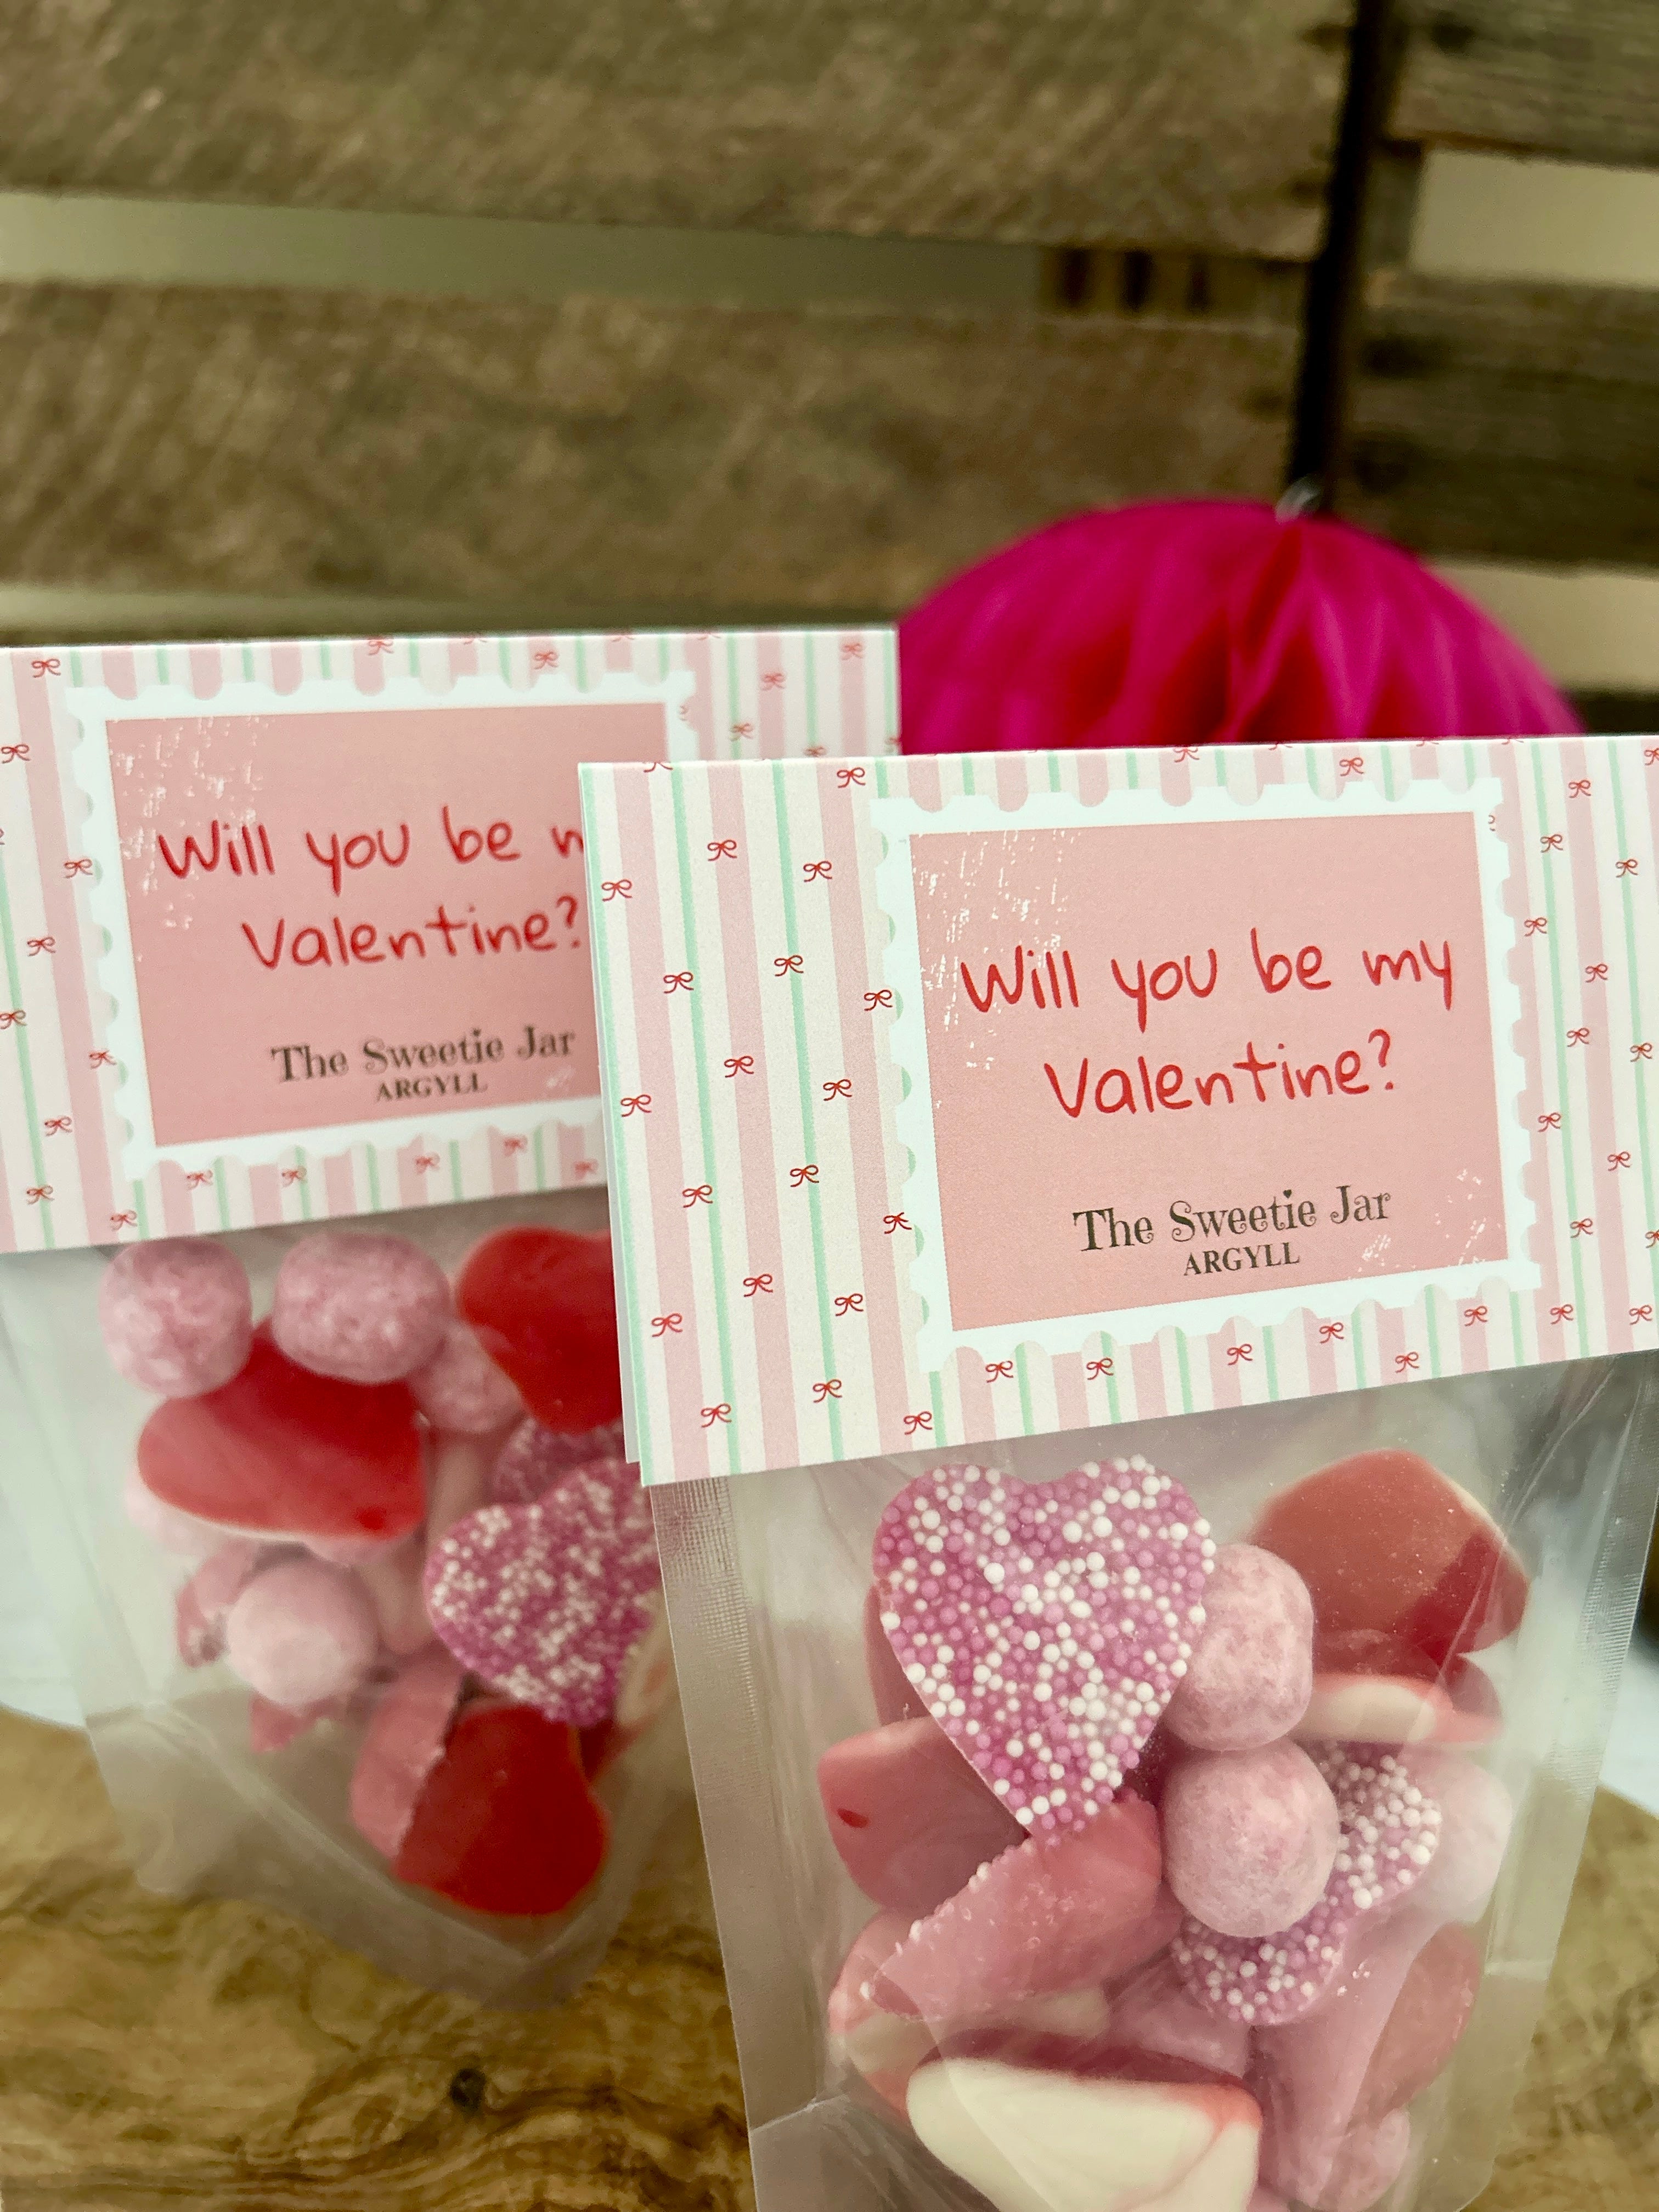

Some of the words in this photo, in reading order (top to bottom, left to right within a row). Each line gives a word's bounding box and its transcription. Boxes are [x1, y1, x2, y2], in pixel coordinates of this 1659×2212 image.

[157, 820, 275, 879] Will
[305, 823, 410, 896] you
[442, 805, 521, 863] be
[241, 895, 580, 969] Valentine?
[960, 945, 1080, 1013] Will
[1110, 947, 1218, 1033] you
[1250, 927, 1331, 994] be
[1362, 939, 1454, 1010] my
[270, 1042, 348, 1083] The
[363, 1028, 504, 1073] Sweetie
[517, 1025, 576, 1062] Jar
[376, 1072, 488, 1102] ARGYLL
[1043, 1028, 1395, 1118] Valentine?
[1072, 1207, 1155, 1252] The
[1169, 1188, 1317, 1243] Sweetie
[1330, 1184, 1392, 1224] Jar
[1182, 1242, 1301, 1276] ARGYLL
